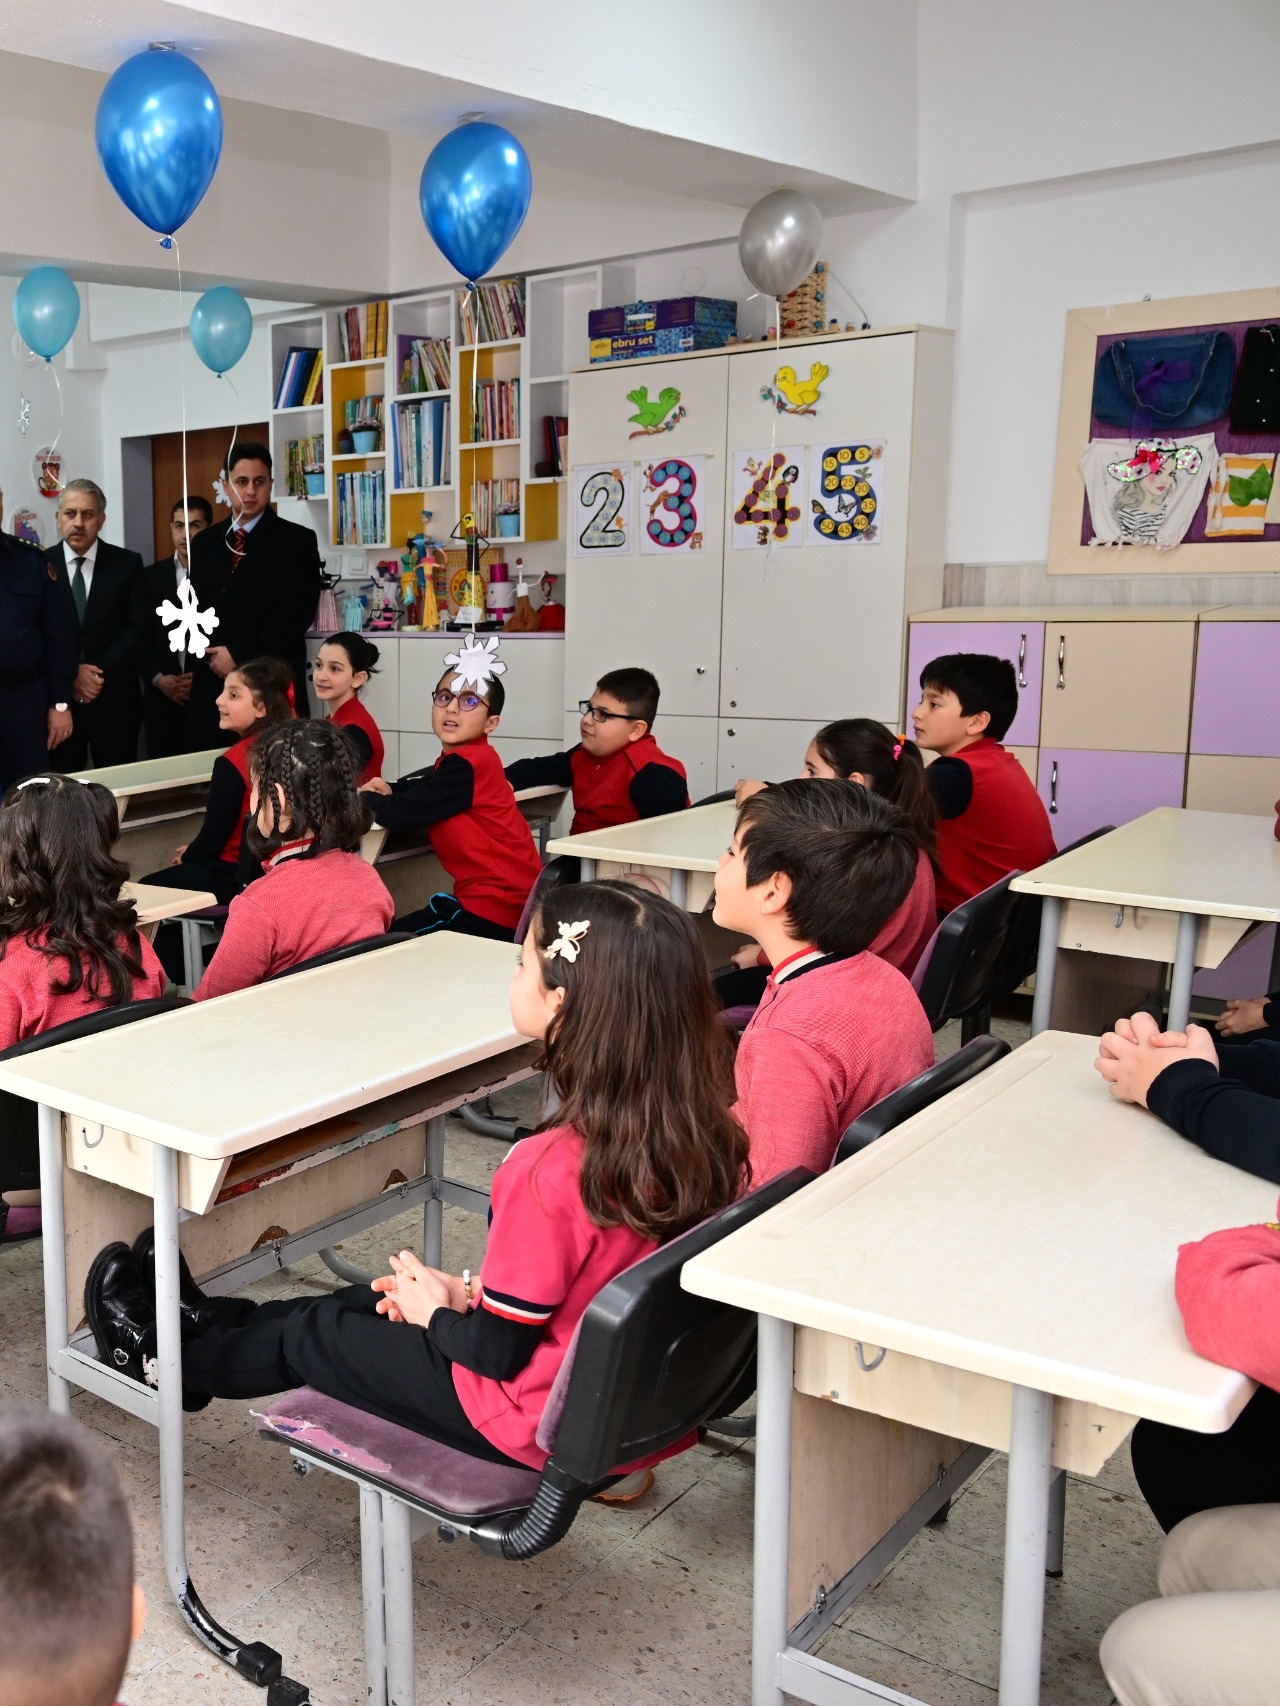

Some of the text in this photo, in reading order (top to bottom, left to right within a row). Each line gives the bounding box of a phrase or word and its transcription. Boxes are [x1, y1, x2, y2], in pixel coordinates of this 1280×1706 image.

[612, 338, 635, 348] ebru
[638, 335, 653, 345] set
[840, 451, 849, 460] 10
[860, 450, 865, 458] 5
[825, 460, 834, 469] 15
[826, 478, 837, 487] 20
[843, 478, 854, 487] 25
[814, 445, 877, 540] 5
[857, 484, 868, 493] 30
[734, 453, 801, 542] 4
[647, 459, 697, 548] 3
[863, 501, 874, 509] 35
[580, 472, 626, 548] 2
[855, 517, 867, 526] 40
